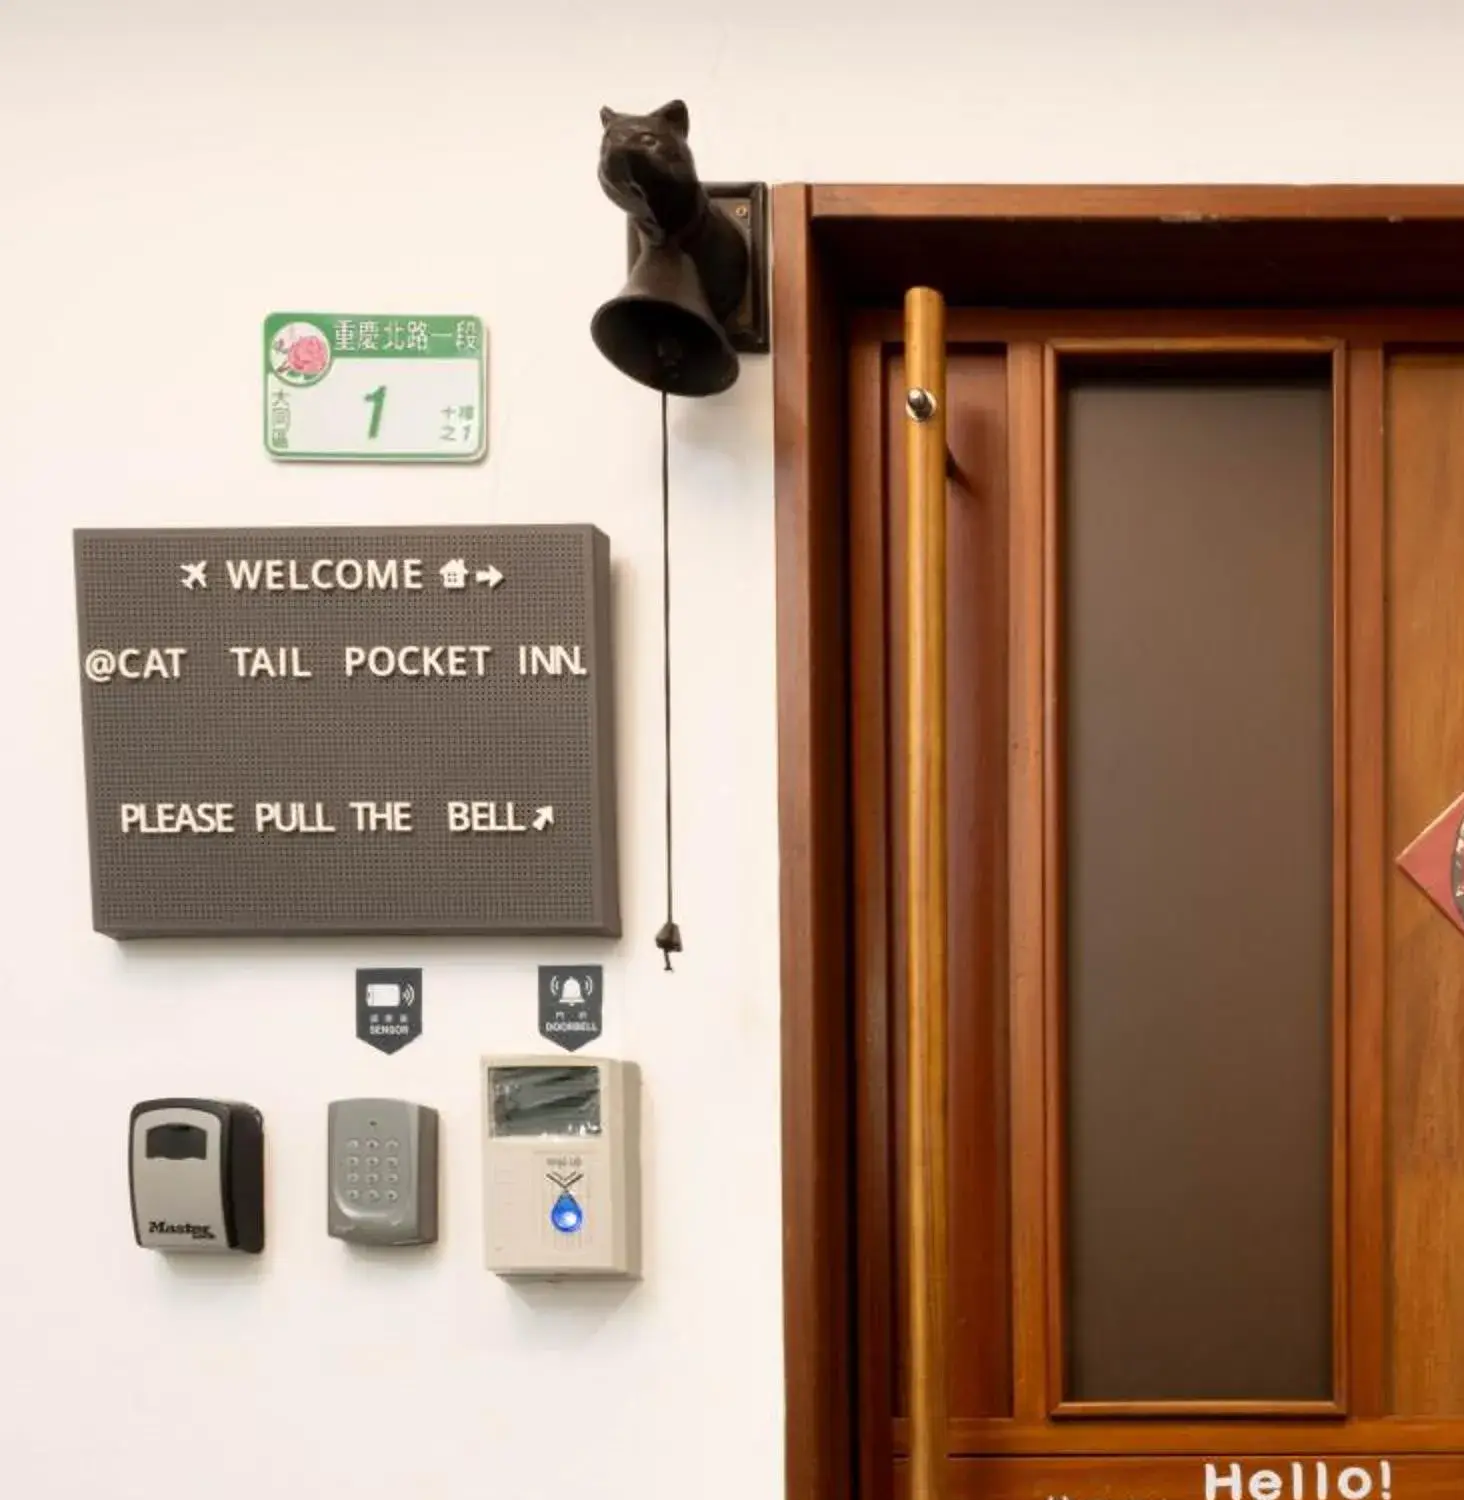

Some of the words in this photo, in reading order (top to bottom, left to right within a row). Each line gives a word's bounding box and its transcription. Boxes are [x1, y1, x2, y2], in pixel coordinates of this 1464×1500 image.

[333, 319, 477, 351] 重慶北路一段
[364, 385, 387, 440] 1
[226, 558, 423, 590] WELCOME
[84, 648, 187, 683] @CAT
[230, 646, 312, 678] TAIL
[345, 645, 492, 677] POCKET
[120, 802, 235, 833] PLEASE
[255, 801, 335, 833] PULL
[349, 801, 412, 832] THE
[447, 801, 527, 832] BELL
[369, 1023, 409, 1035] SENSOR
[545, 1021, 598, 1032] DOORBELL
